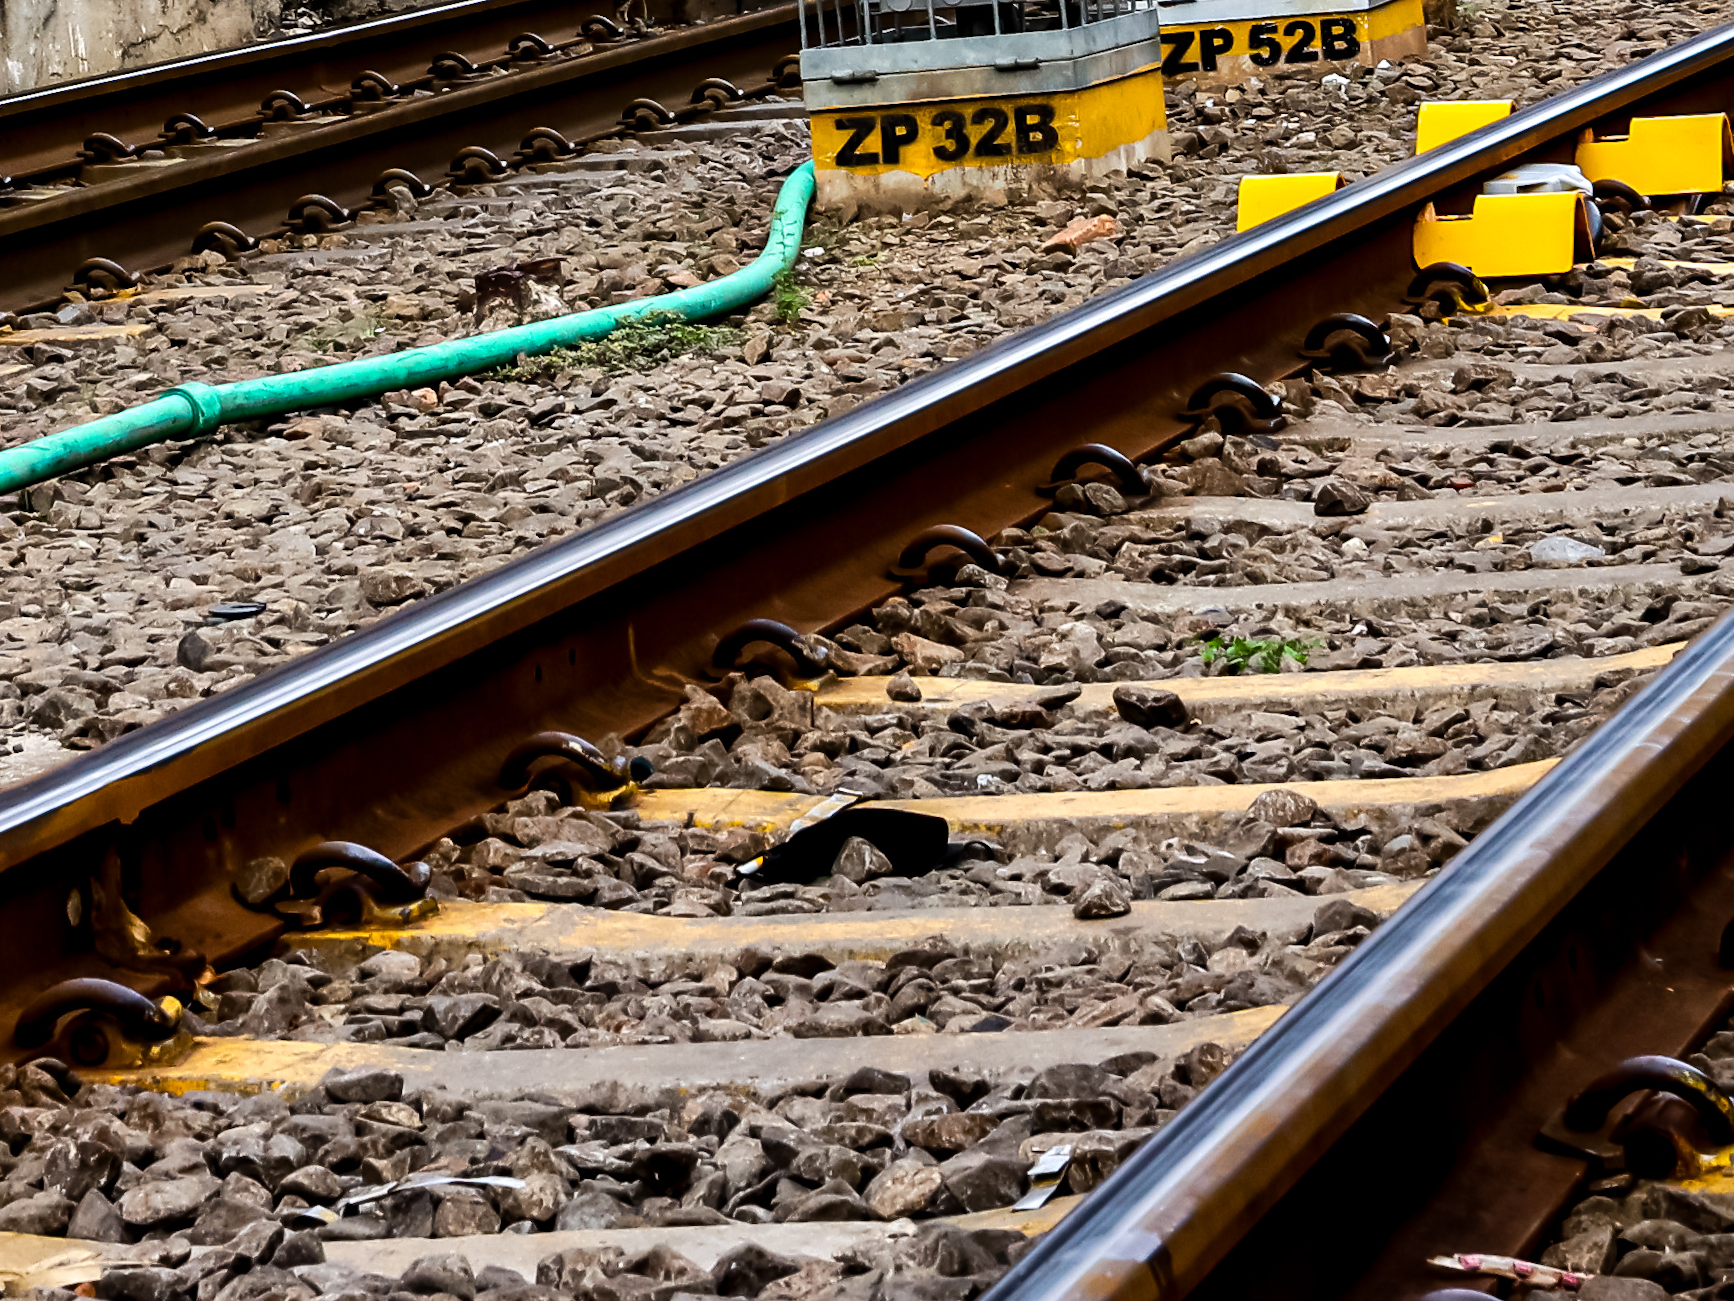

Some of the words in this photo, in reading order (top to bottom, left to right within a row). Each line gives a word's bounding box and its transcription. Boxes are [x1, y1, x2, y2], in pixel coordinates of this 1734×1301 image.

[1160, 27, 1234, 77] ZP
[1248, 17, 1361, 67] 52B
[835, 113, 919, 166] ZP
[930, 103, 1059, 162] 32B
